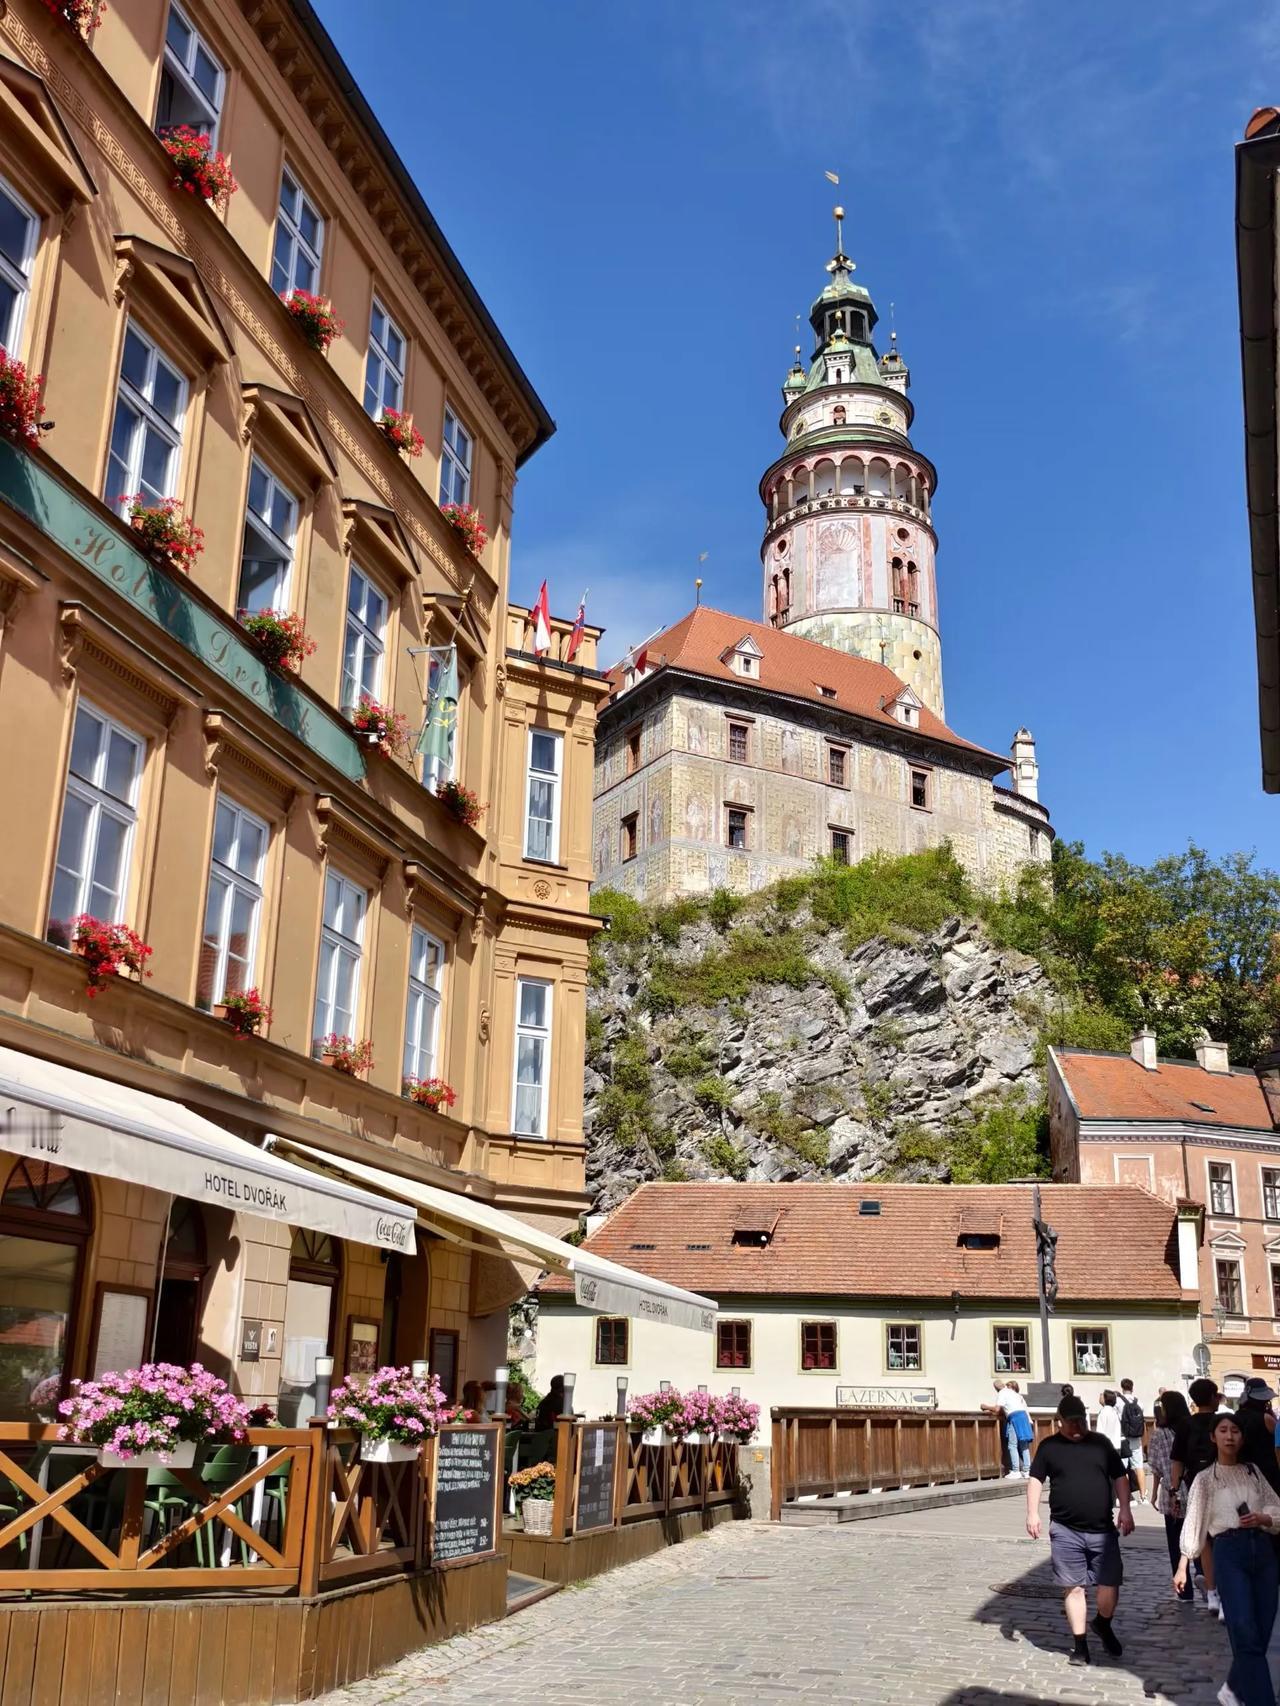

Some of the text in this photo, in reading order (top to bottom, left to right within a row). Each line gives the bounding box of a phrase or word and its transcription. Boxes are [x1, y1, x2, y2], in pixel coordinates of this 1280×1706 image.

[211, 631, 313, 738] Dvok
[205, 1172, 287, 1211] HOTEL DVOŘÁK
[839, 1389, 909, 1404] LAZEBNA
